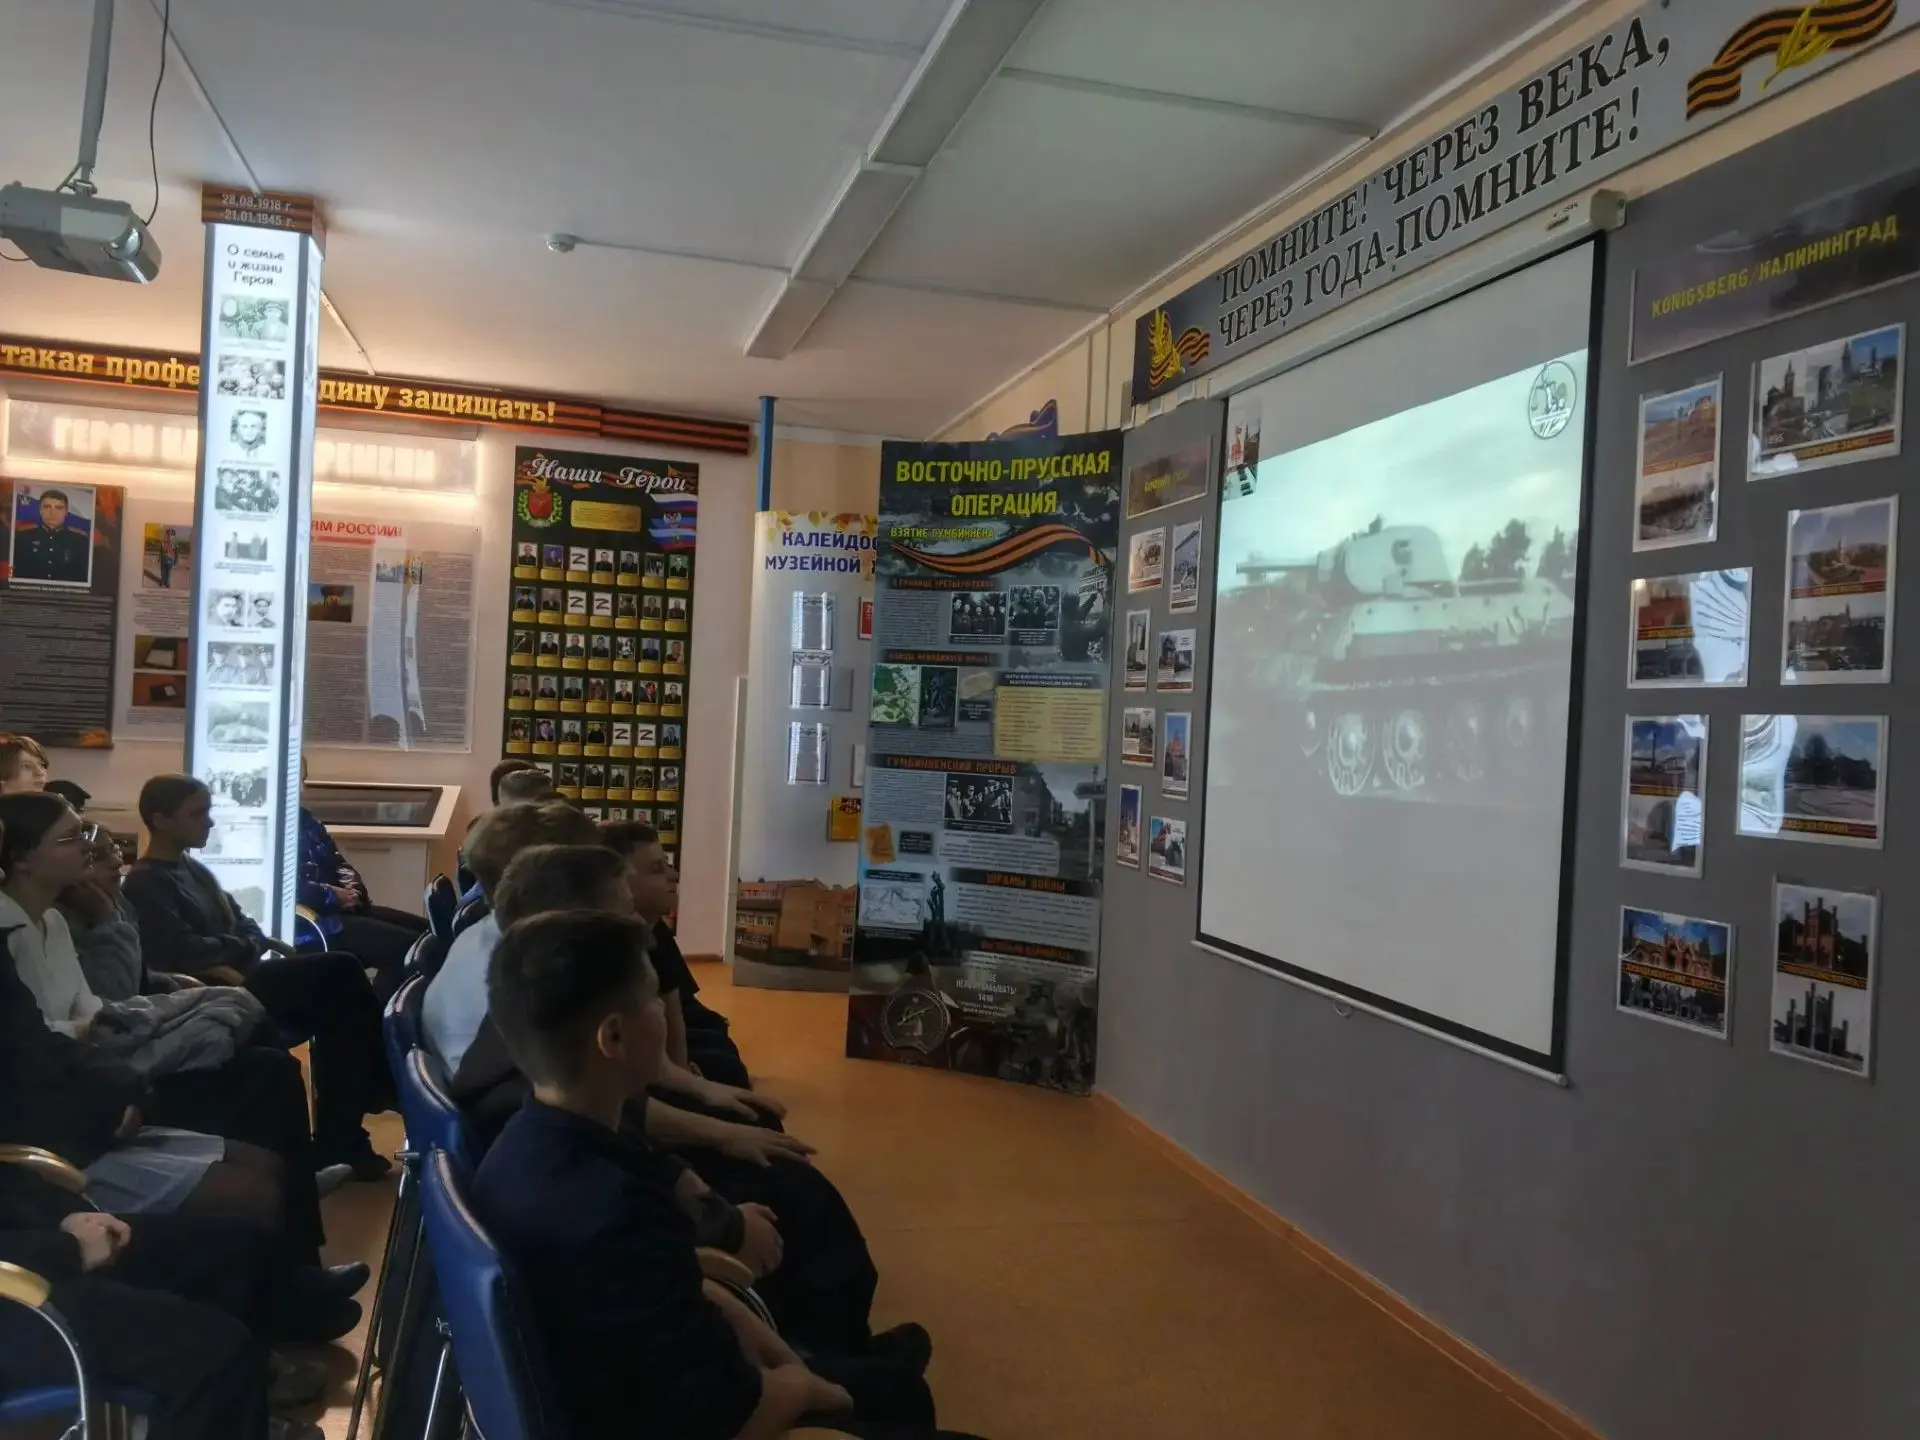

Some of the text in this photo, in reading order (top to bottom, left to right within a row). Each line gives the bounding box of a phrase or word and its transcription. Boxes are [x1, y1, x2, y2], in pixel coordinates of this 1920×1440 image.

[1220, 16, 1670, 305] ПОМНИТЕ! ЧЕРЕЗ ВЕКА,
[227, 243, 285, 261] О семье
[1758, 214, 1898, 281] КАЛИНИНГРАД
[228, 259, 283, 274] и жизни
[1219, 279, 1294, 347] ЧЕРЕЗ
[1, 344, 556, 424] такая профе дину защищать!
[315, 439, 436, 482] РЕМЕНИ
[527, 457, 687, 494] Наши Герои
[896, 450, 1111, 483] ВОСТОЧНО-ПРУССКАЯ
[951, 490, 1058, 518] ОПЕРАЦИЯ
[782, 530, 878, 551] КАЛЕЙДО
[890, 527, 928, 538] ВЗЯТИЕ
[765, 553, 861, 574] МУЗЕЙНОЙ
